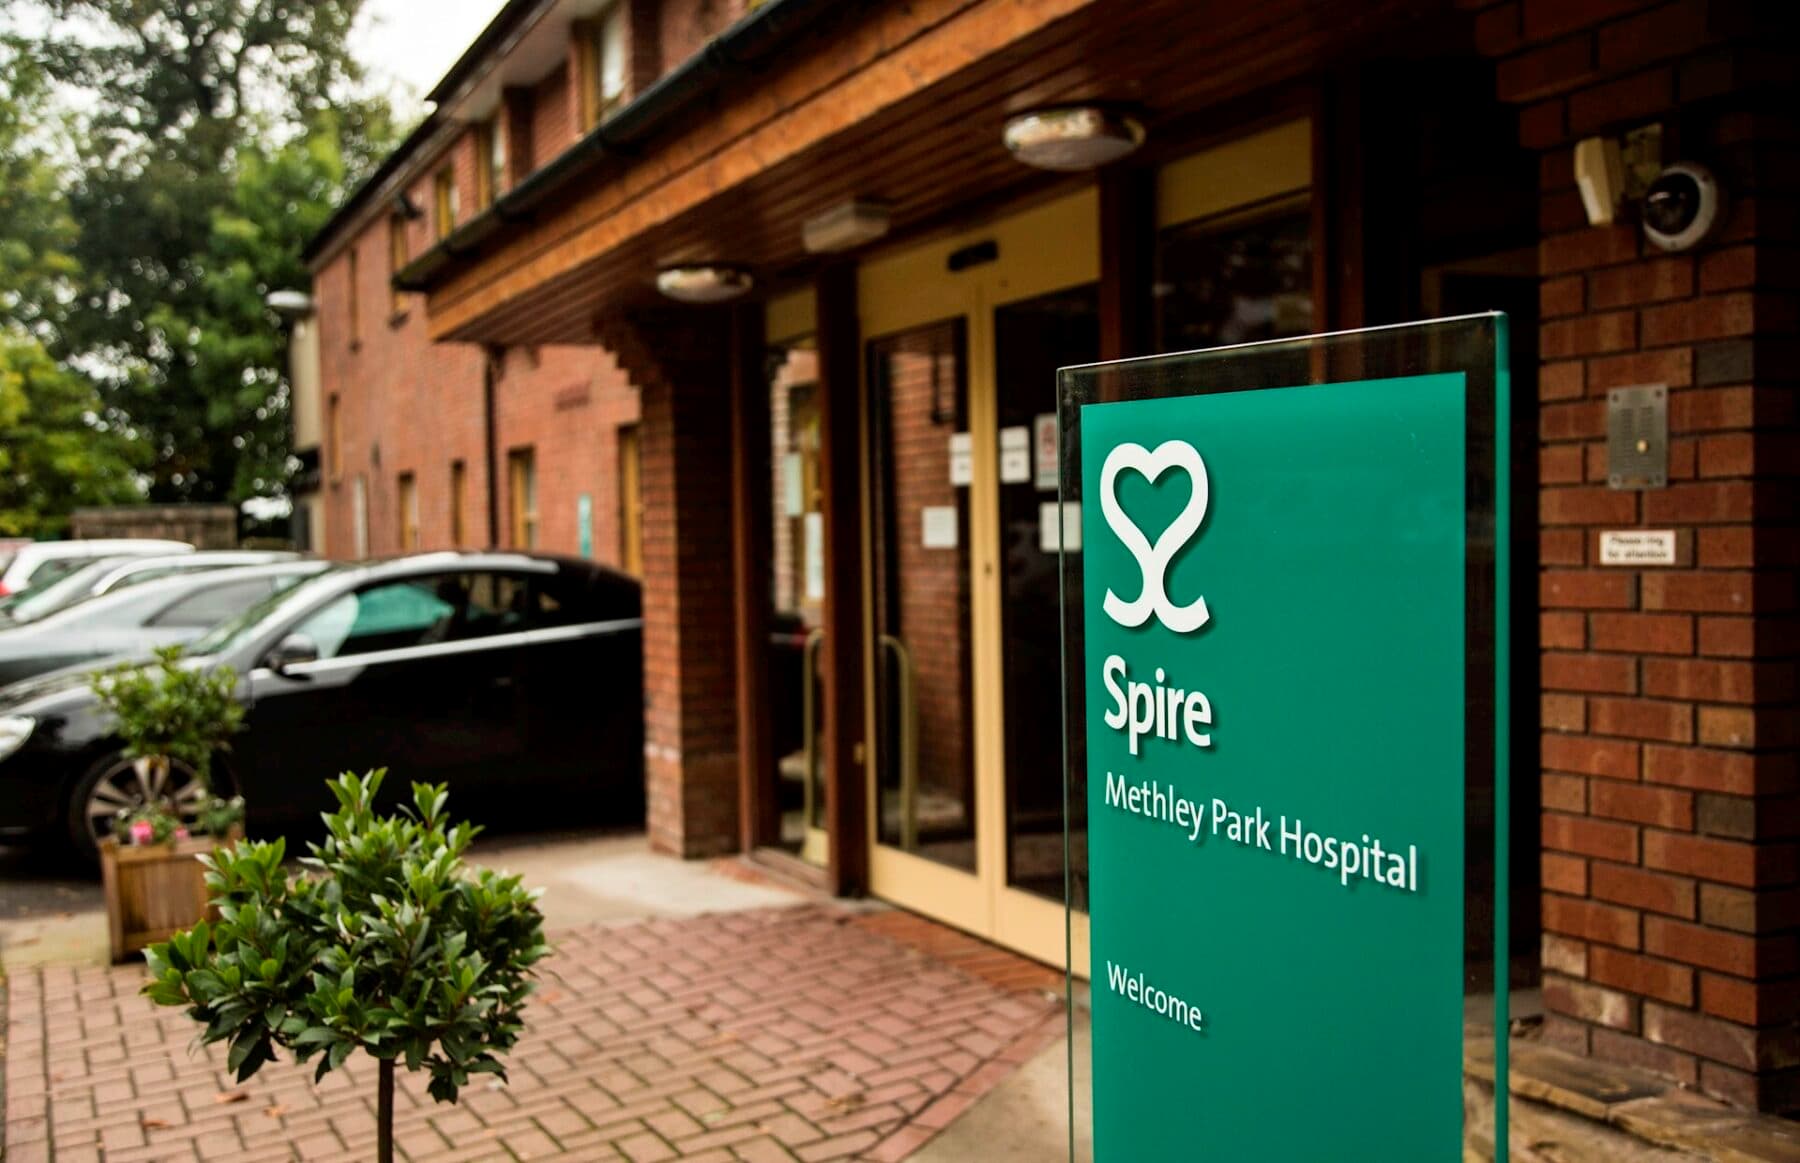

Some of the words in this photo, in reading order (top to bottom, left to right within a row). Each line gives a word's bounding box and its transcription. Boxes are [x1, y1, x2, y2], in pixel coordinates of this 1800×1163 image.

[1103, 654, 1212, 755] Spire
[1105, 771, 1204, 841] Methley
[1212, 798, 1271, 850] Park
[1280, 815, 1417, 891] Hospital
[1107, 960, 1202, 1031] Welcome
